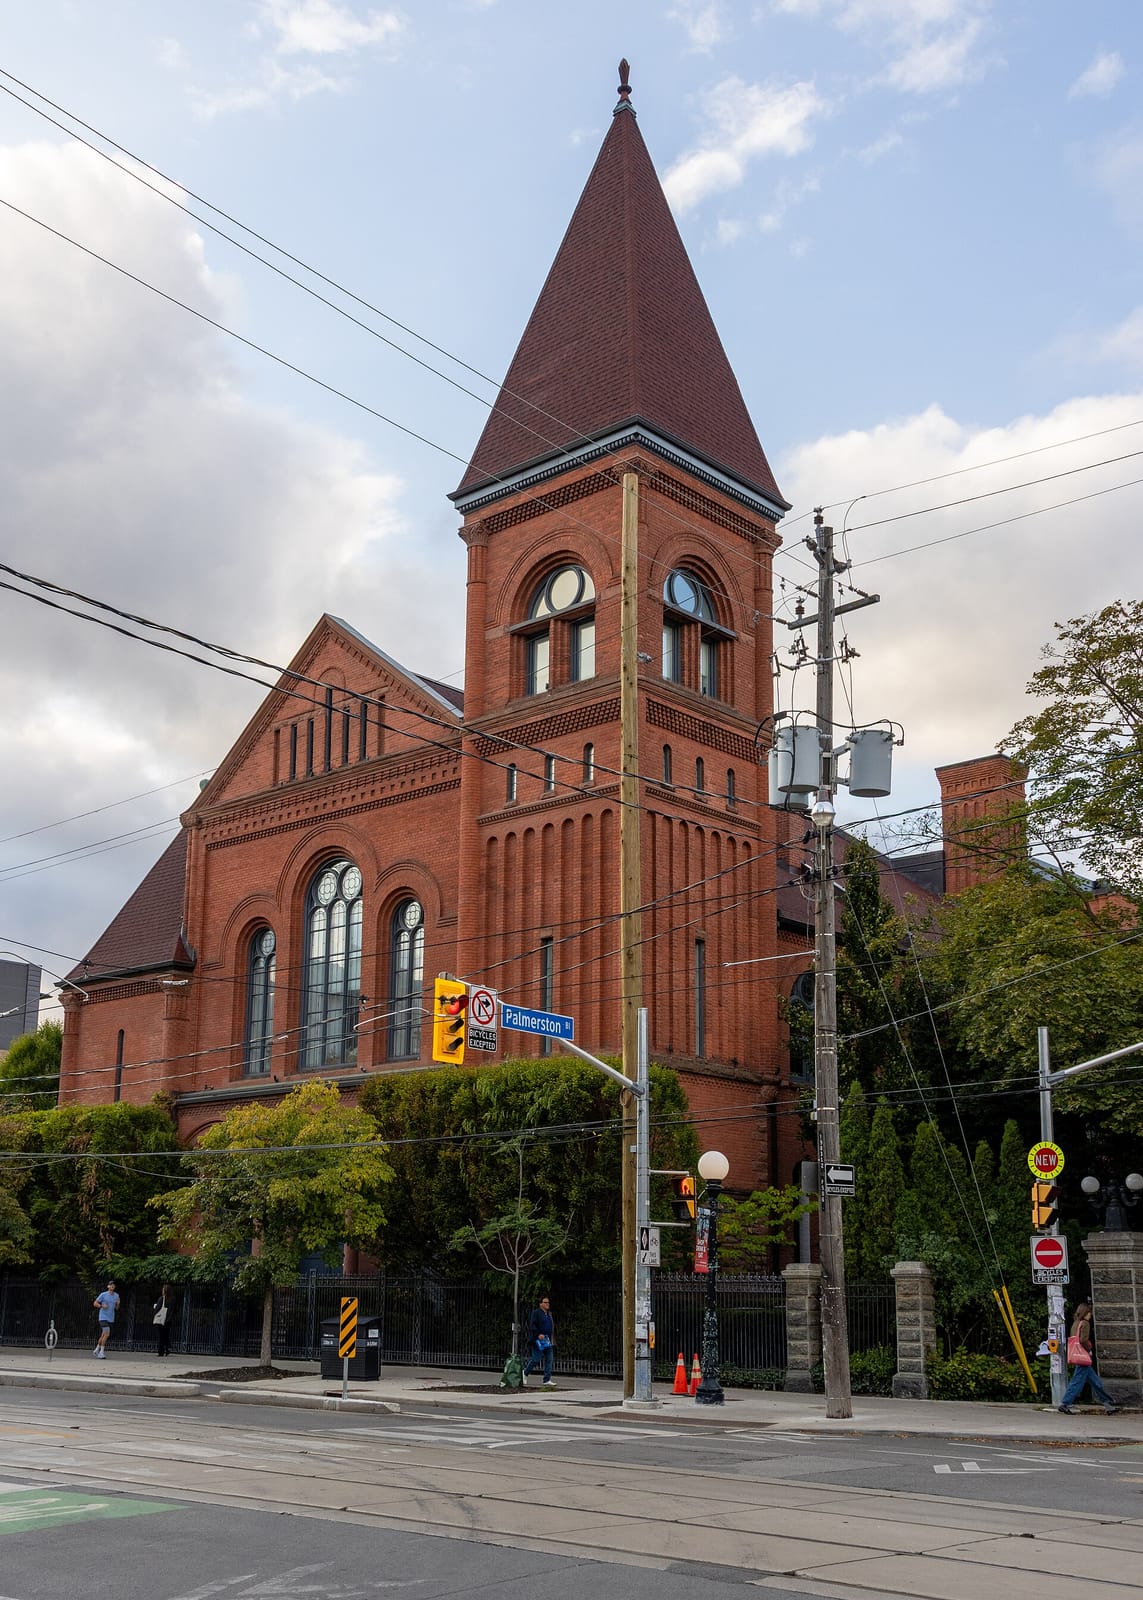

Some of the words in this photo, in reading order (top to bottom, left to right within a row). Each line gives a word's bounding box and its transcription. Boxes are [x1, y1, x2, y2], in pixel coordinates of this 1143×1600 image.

[505, 1008, 561, 1034] Palmerston
[469, 1028, 496, 1041] BICYCLES
[469, 1038, 496, 1050] EXCEPTED
[1035, 1154, 1057, 1167] NEW
